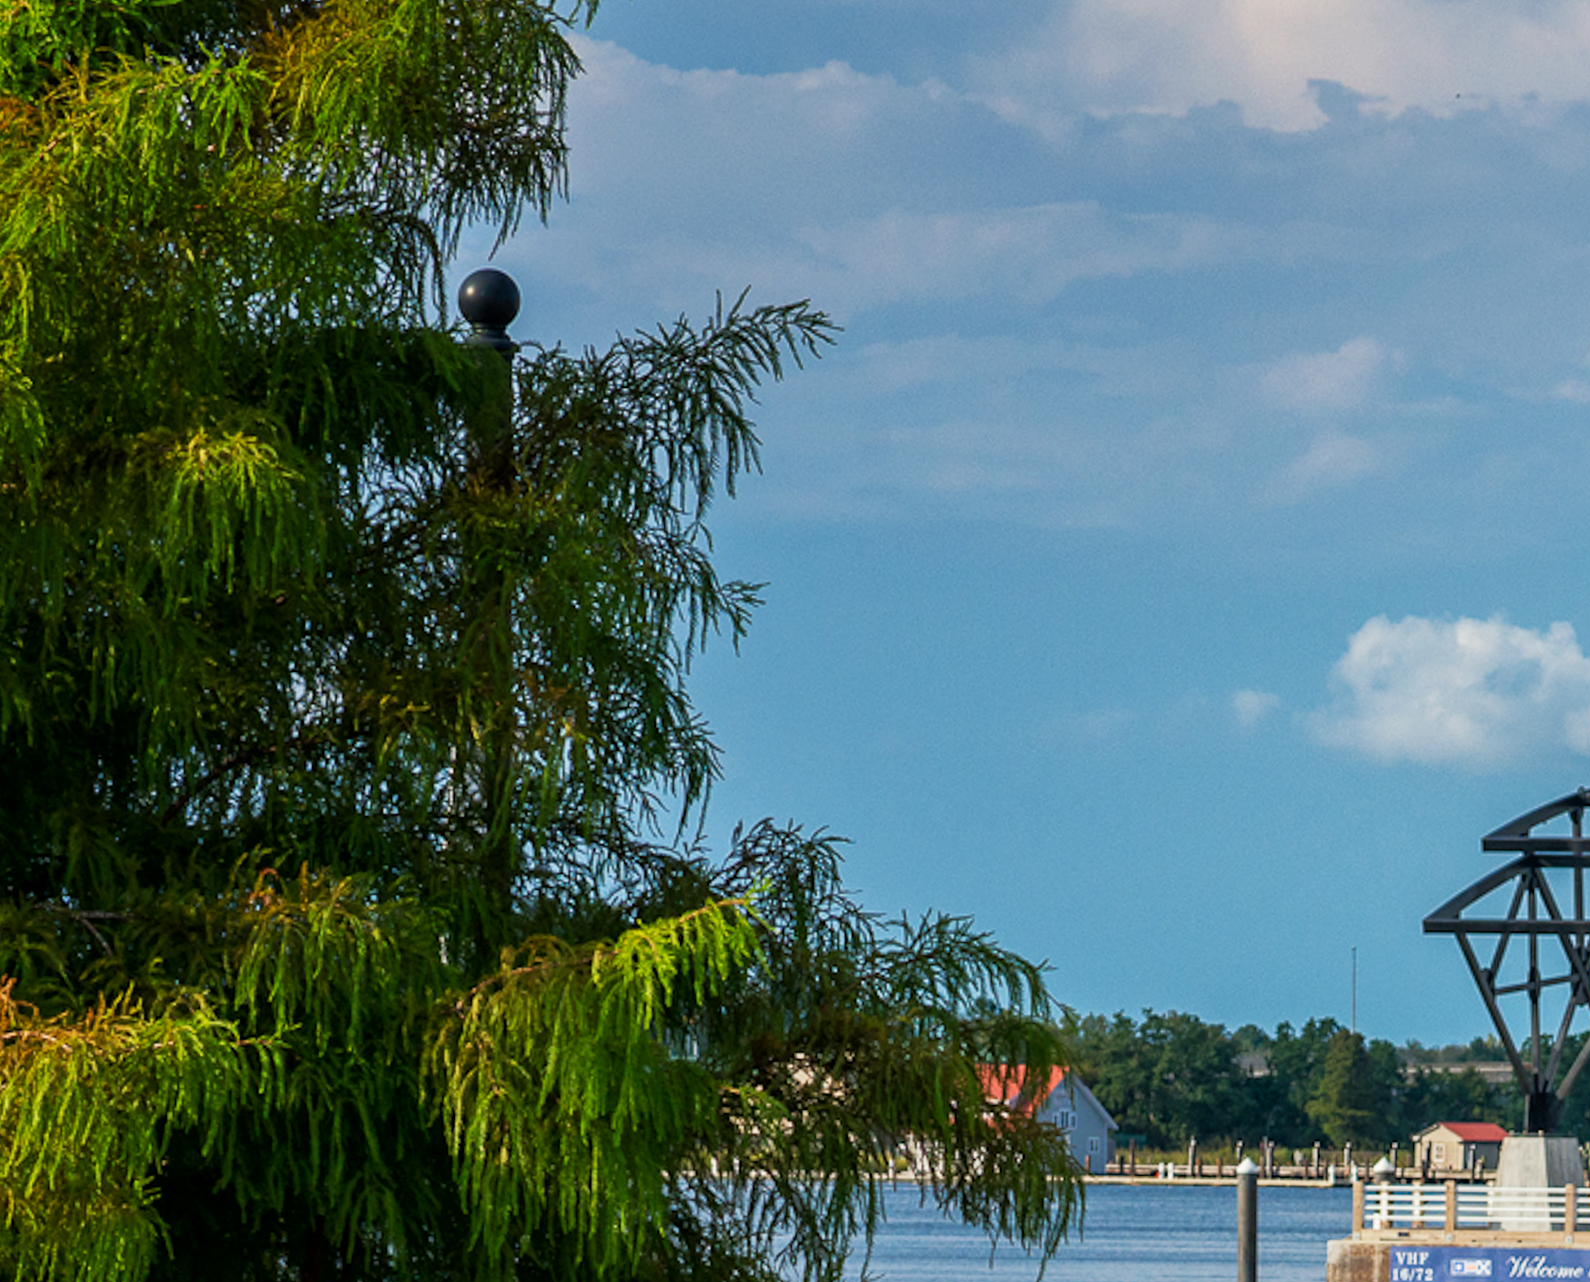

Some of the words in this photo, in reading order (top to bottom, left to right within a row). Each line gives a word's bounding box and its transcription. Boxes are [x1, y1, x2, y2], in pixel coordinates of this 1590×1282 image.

[1395, 1252, 1429, 1265] VHF
[1505, 1255, 1584, 1279] Welcome
[1392, 1268, 1434, 1282] 16/72
